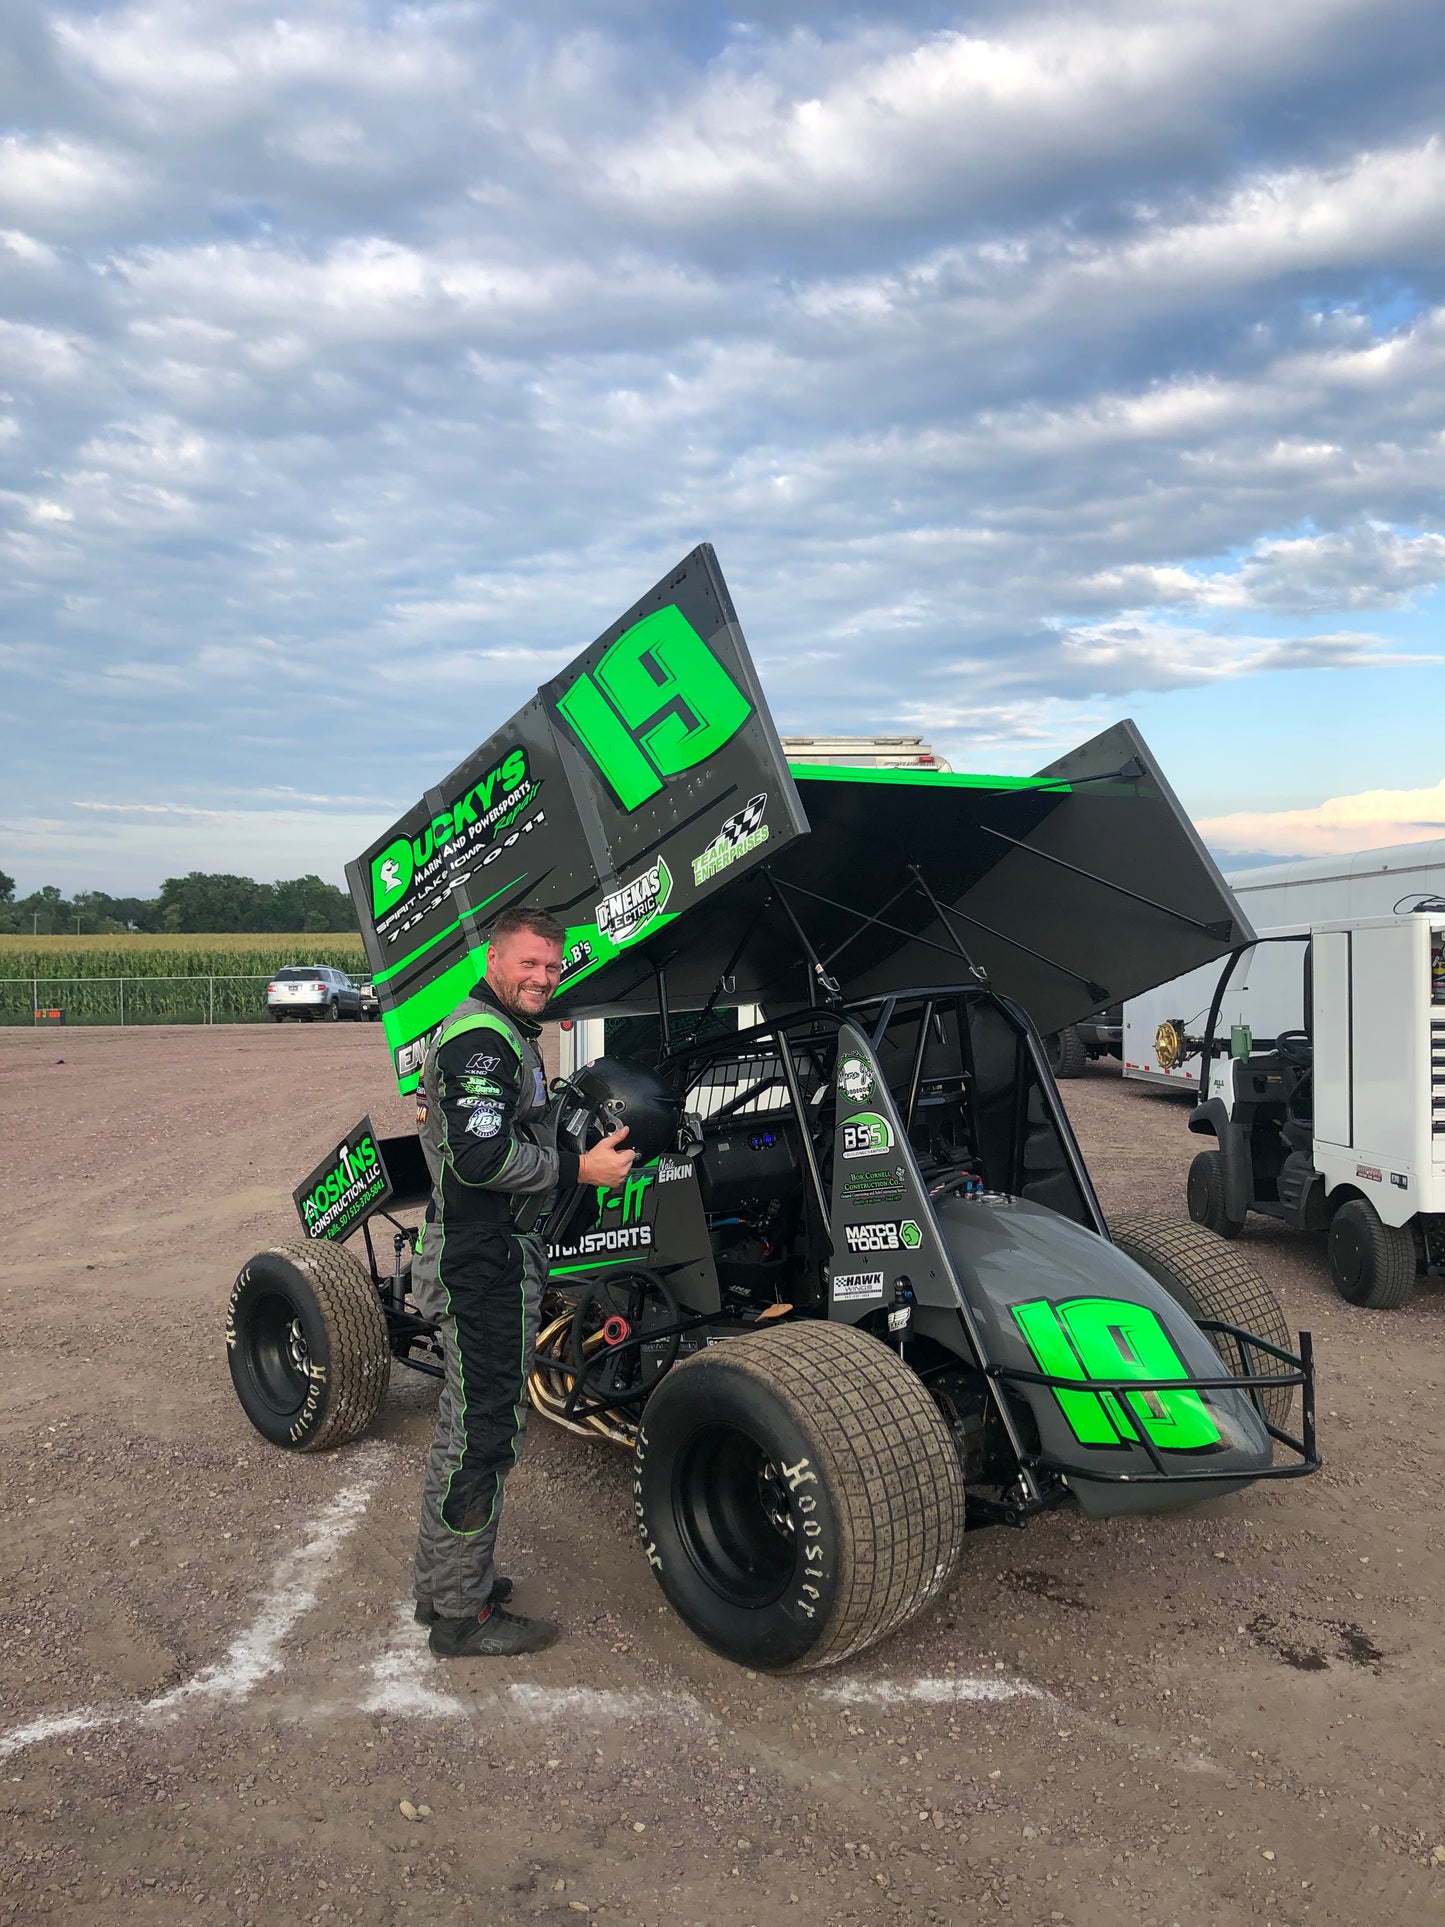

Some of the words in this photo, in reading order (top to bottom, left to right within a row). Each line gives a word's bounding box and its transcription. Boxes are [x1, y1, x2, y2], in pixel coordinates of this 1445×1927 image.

[555, 603, 752, 812] 19
[371, 750, 526, 920] DUCKY'S
[443, 835, 466, 858] AND
[468, 780, 531, 840] POWERSPORTS
[691, 837, 729, 872] TEAM
[694, 825, 769, 887] ENTERPRISES
[844, 1123, 882, 1150] BSS
[302, 1137, 377, 1227] HOSKINS
[658, 1163, 693, 1183] EAKIN
[309, 1178, 368, 1238] CONSTRUCTION,
[365, 1162, 381, 1183] LLC
[845, 1223, 898, 1239] MATCO
[848, 1235, 900, 1252] TOOLS
[845, 1284, 873, 1292] WINGS
[846, 1273, 882, 1287] HAWK
[1011, 1299, 1222, 1449] 19
